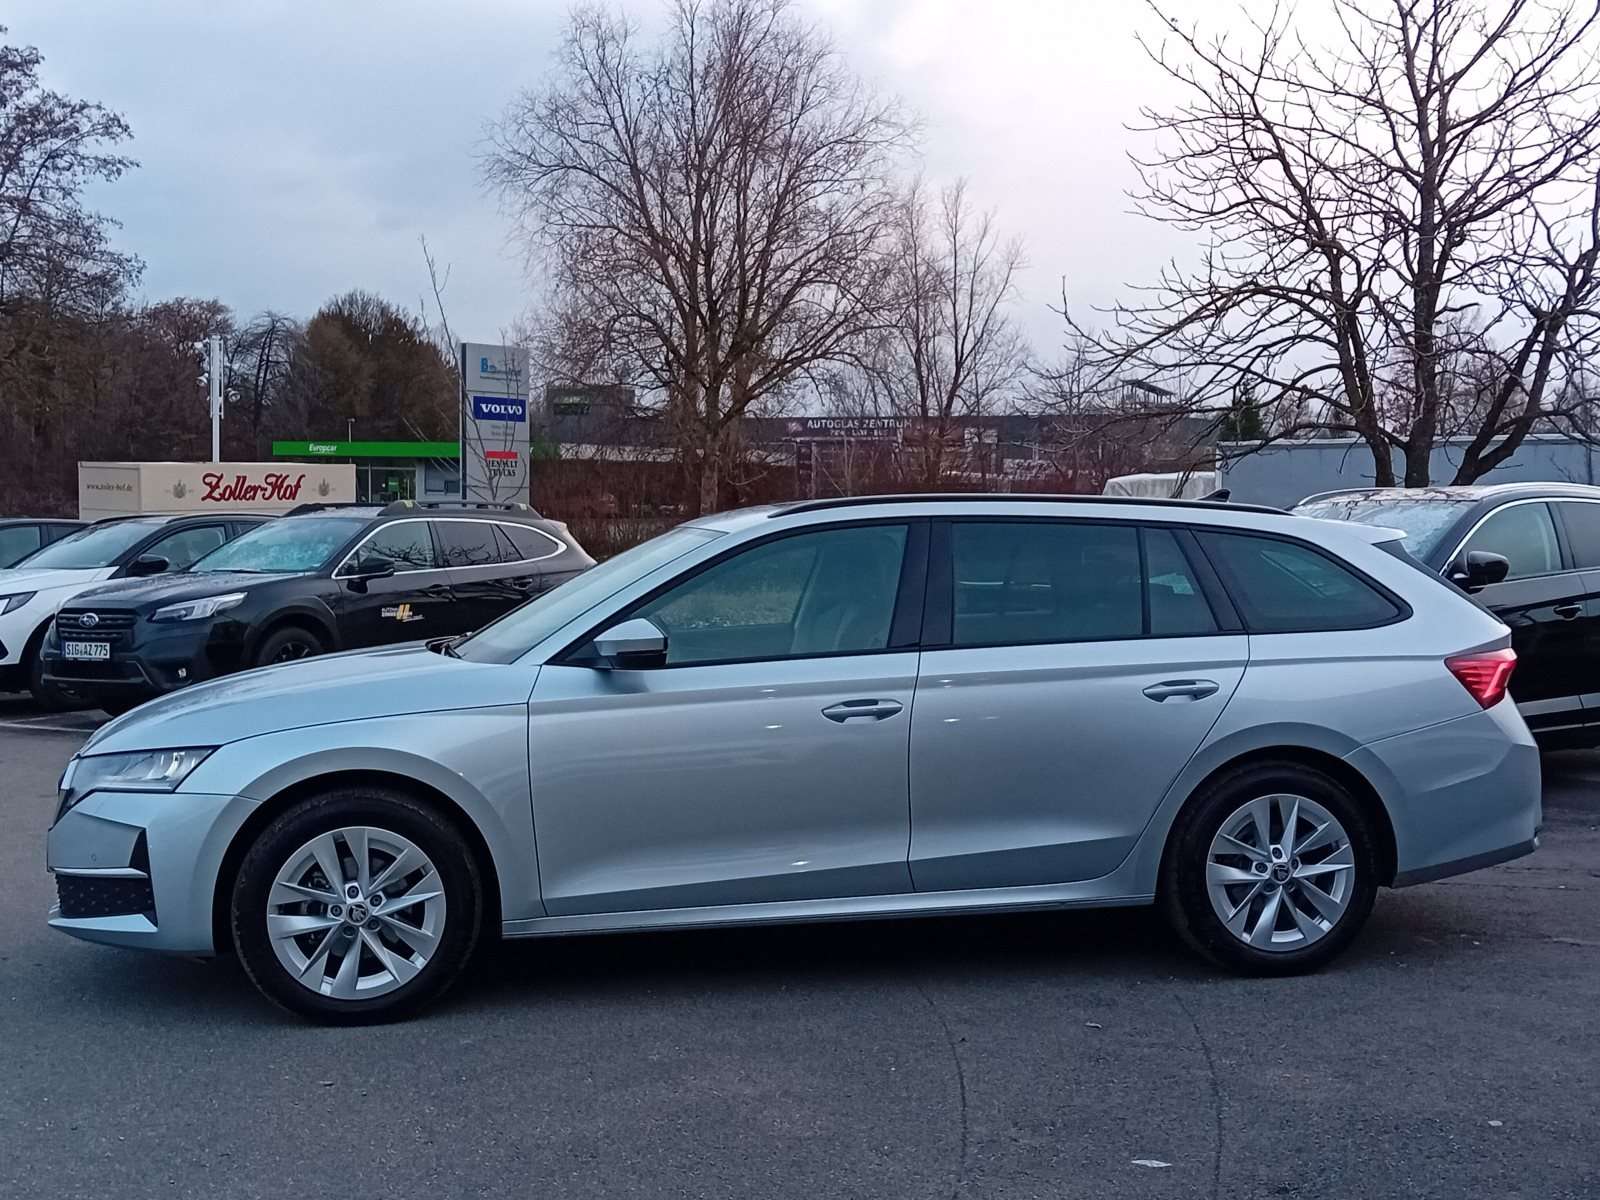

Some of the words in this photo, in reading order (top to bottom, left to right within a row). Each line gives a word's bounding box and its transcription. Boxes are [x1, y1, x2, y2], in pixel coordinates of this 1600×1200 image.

[480, 403, 523, 415] VOLVO
[807, 419, 860, 429] AUTOGLAS
[309, 443, 337, 454] Europcar
[201, 472, 306, 502] Zoller-Hof
[66, 643, 80, 656] SIG
[84, 643, 93, 657] AZ
[94, 644, 108, 657] 775
